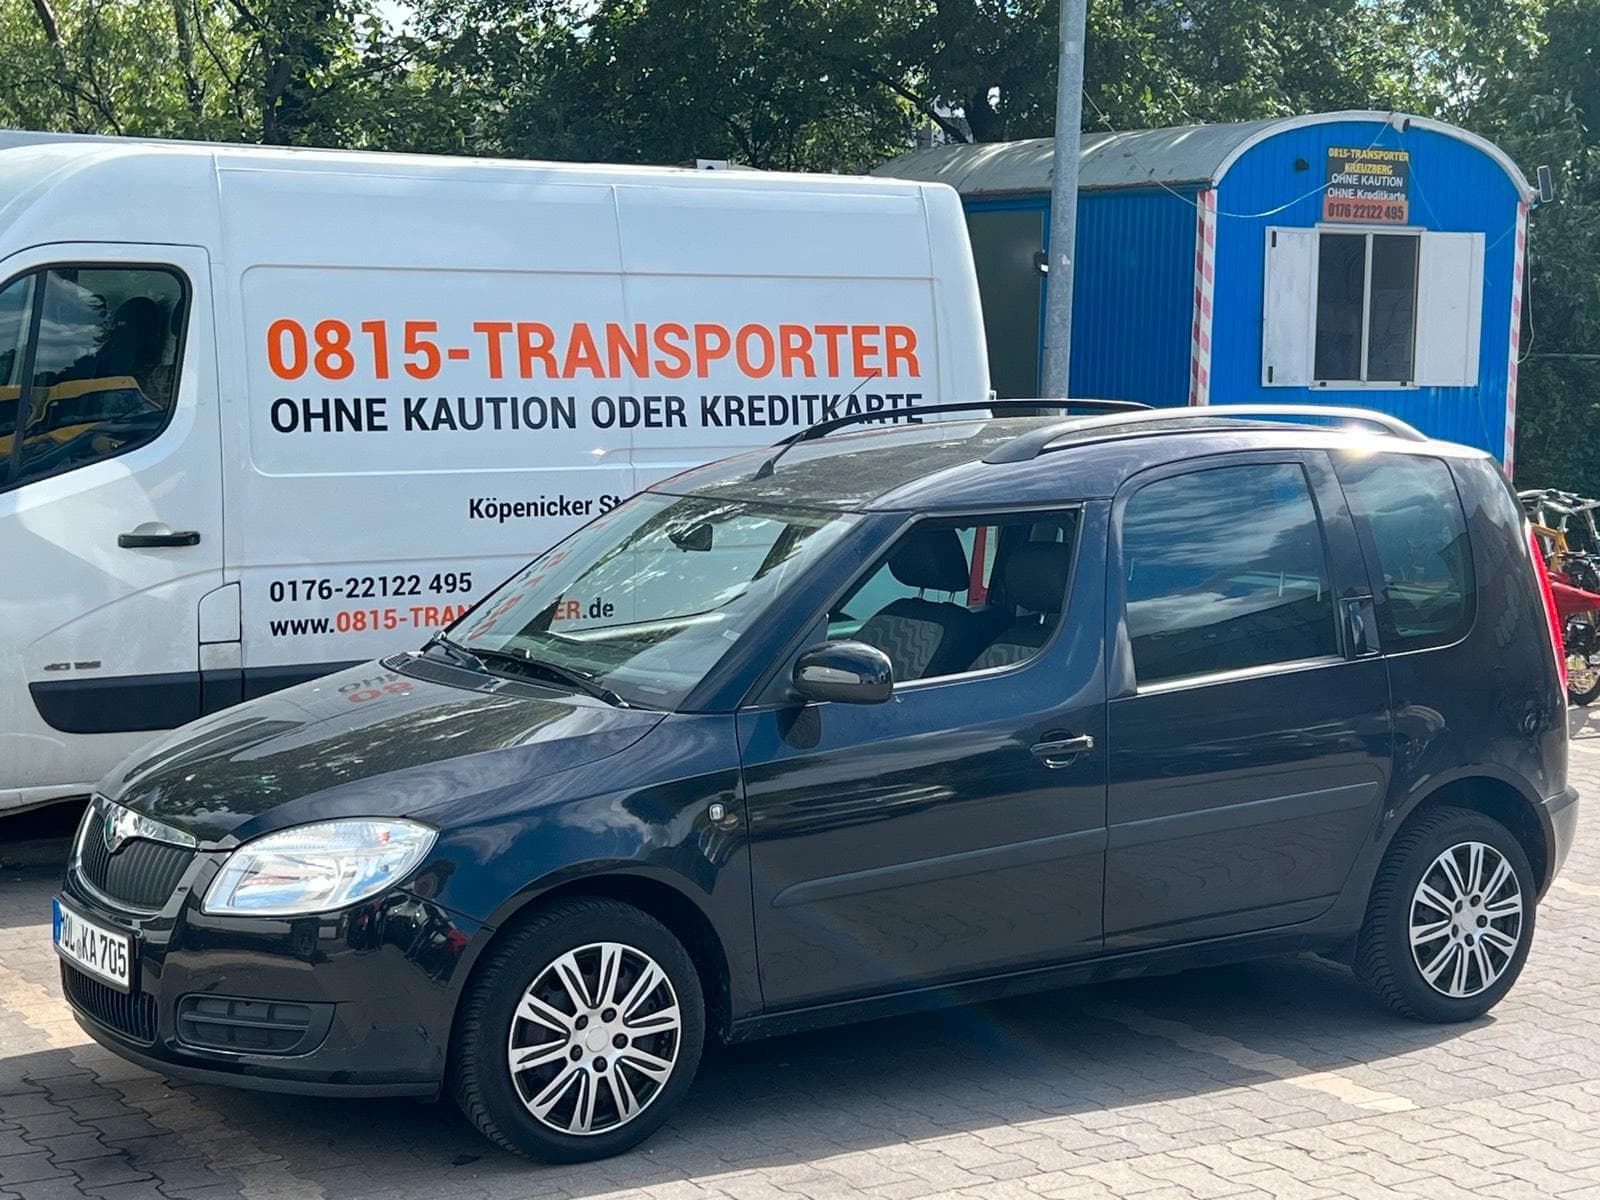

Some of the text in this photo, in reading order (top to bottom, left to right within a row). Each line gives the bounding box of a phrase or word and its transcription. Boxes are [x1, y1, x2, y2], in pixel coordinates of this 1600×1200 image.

[1328, 148, 1409, 161] 0815-TRANSPORTER
[1331, 173, 1403, 187] OHNE KAUTION
[1344, 162, 1393, 175] KREUZBERG
[1327, 187, 1354, 199] OHNE
[1328, 203, 1404, 220] 0176 22122 495
[266, 319, 921, 380] 0815-TRANSPORTER
[270, 394, 923, 433] OHNE KAUTION ODER KREDITKARTE
[469, 494, 627, 523] Köpenicker St
[269, 575, 421, 602] 0176-22122
[428, 572, 473, 594] 495
[81, 924, 97, 967] KA
[100, 934, 127, 978] 705
